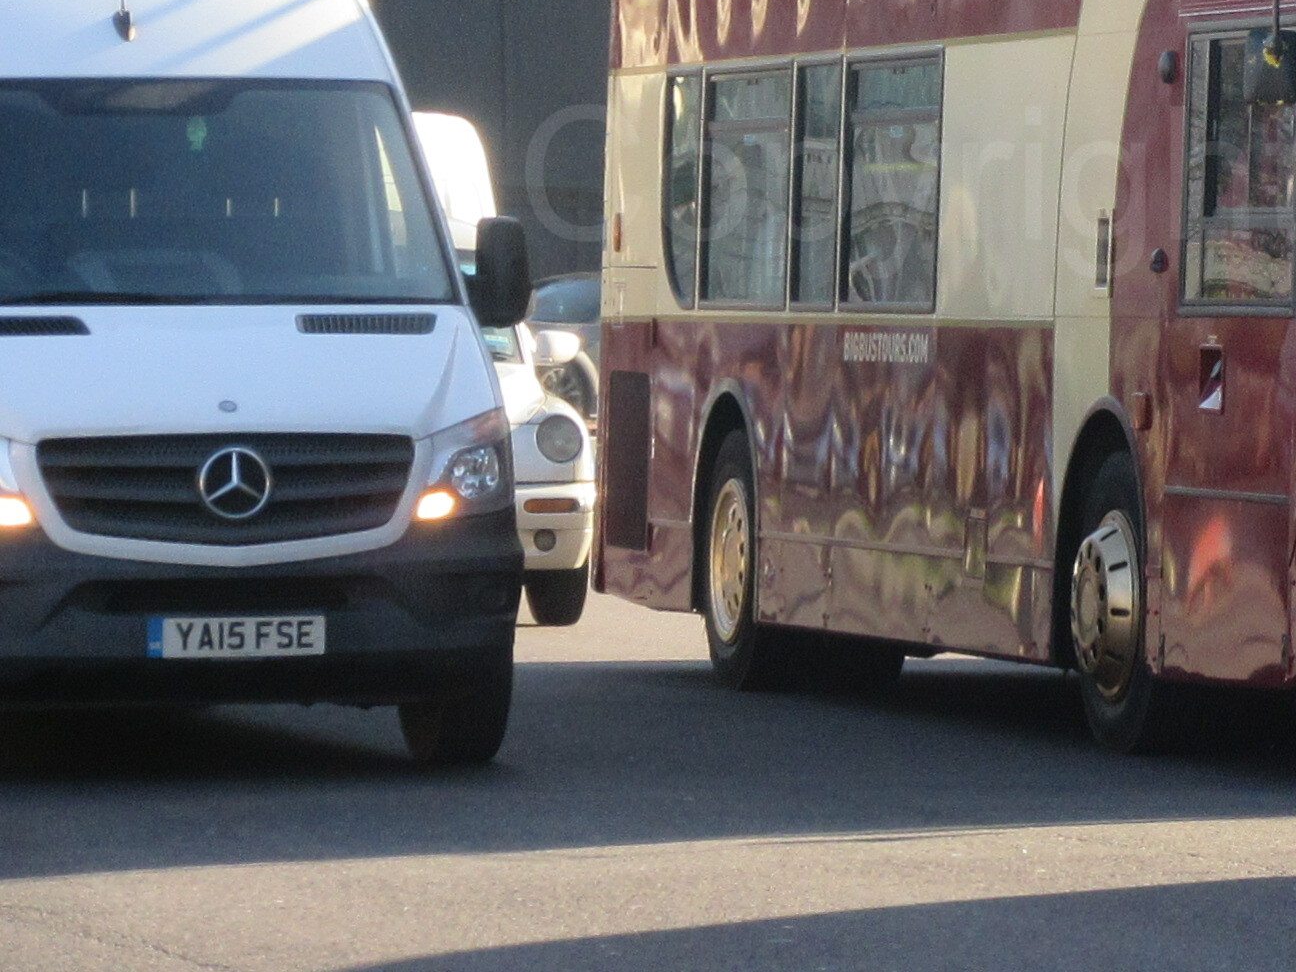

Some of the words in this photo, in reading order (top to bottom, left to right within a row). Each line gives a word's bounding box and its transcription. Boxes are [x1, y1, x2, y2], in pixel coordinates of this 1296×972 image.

[843, 331, 929, 363] BIGBUSTOURS.COM
[175, 621, 246, 651] YA15
[254, 620, 314, 650] FSE
